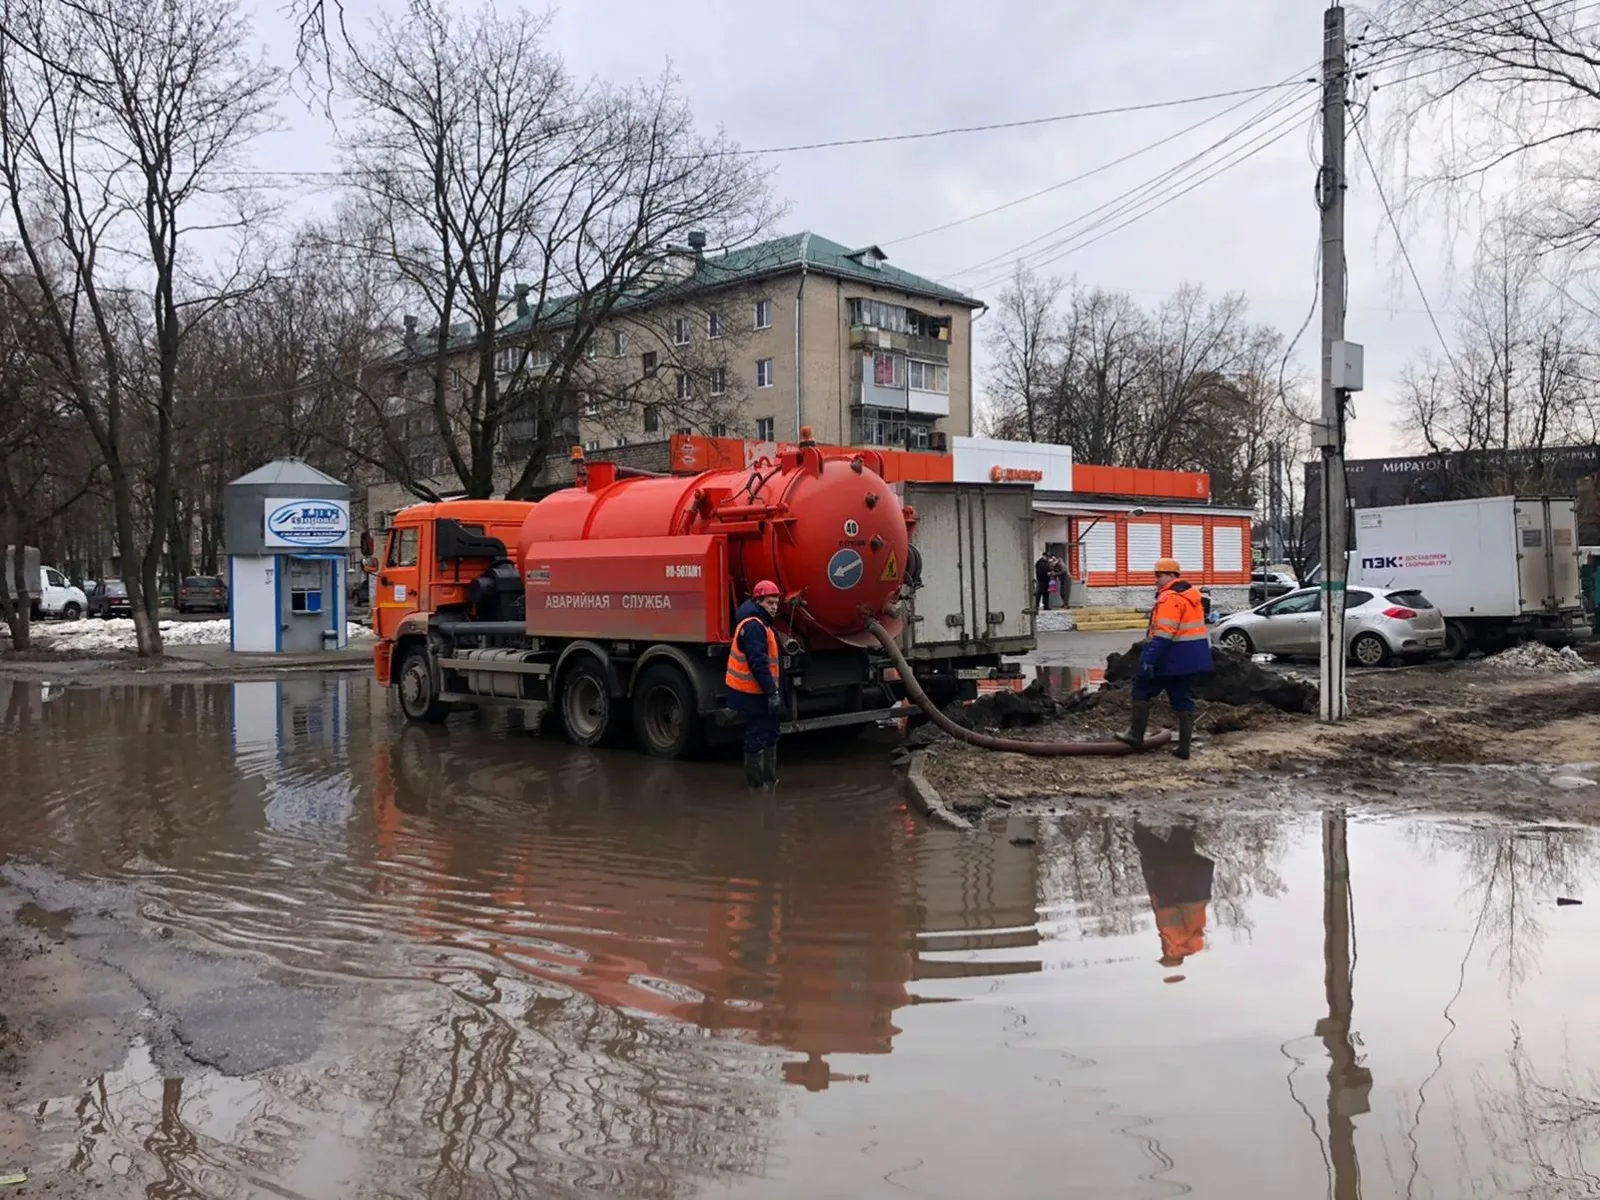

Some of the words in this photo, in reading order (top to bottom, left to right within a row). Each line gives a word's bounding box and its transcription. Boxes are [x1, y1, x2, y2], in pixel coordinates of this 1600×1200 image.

[846, 522, 857, 534] 40
[545, 592, 610, 609] АВАРИЙНАЯ
[622, 594, 672, 609] СЛУЖБА
